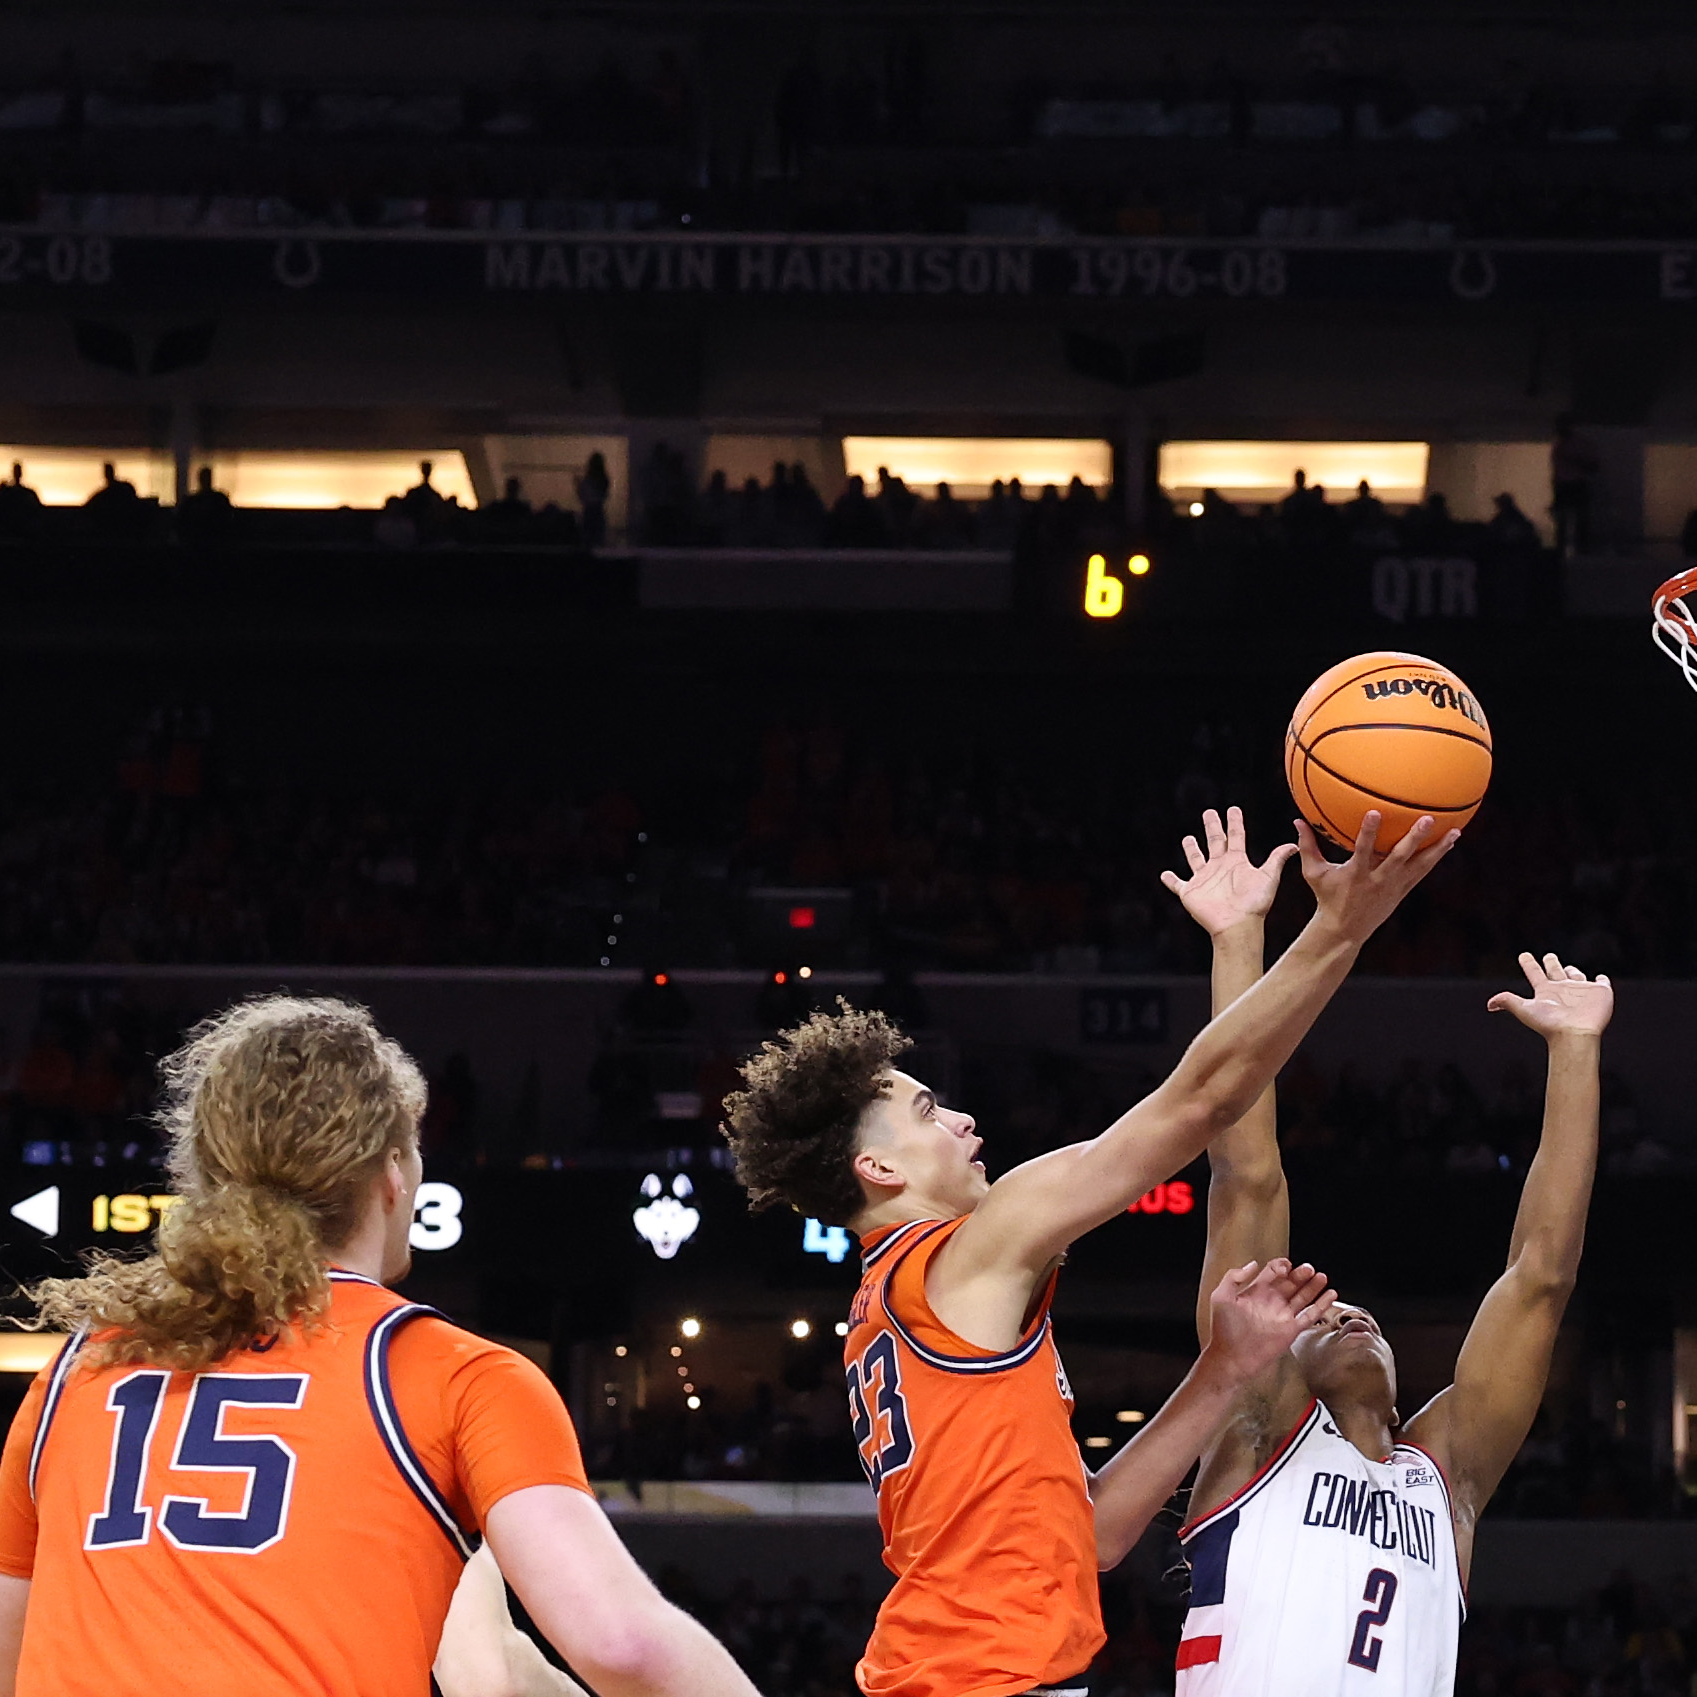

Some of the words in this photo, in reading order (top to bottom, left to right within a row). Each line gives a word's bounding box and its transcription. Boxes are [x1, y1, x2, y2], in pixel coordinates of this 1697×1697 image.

[483, 241, 714, 292] MARVIN
[737, 244, 1035, 295] HARRISON
[1069, 246, 1288, 297] 1996-08
[1372, 556, 1478, 621] QTR
[1362, 678, 1486, 731] Wilson
[846, 1328, 917, 1499] 23
[84, 1370, 309, 1555] 15
[1406, 1468, 1426, 1476] BIG
[1406, 1475, 1435, 1485] EAST
[1347, 1567, 1398, 1674] 2
